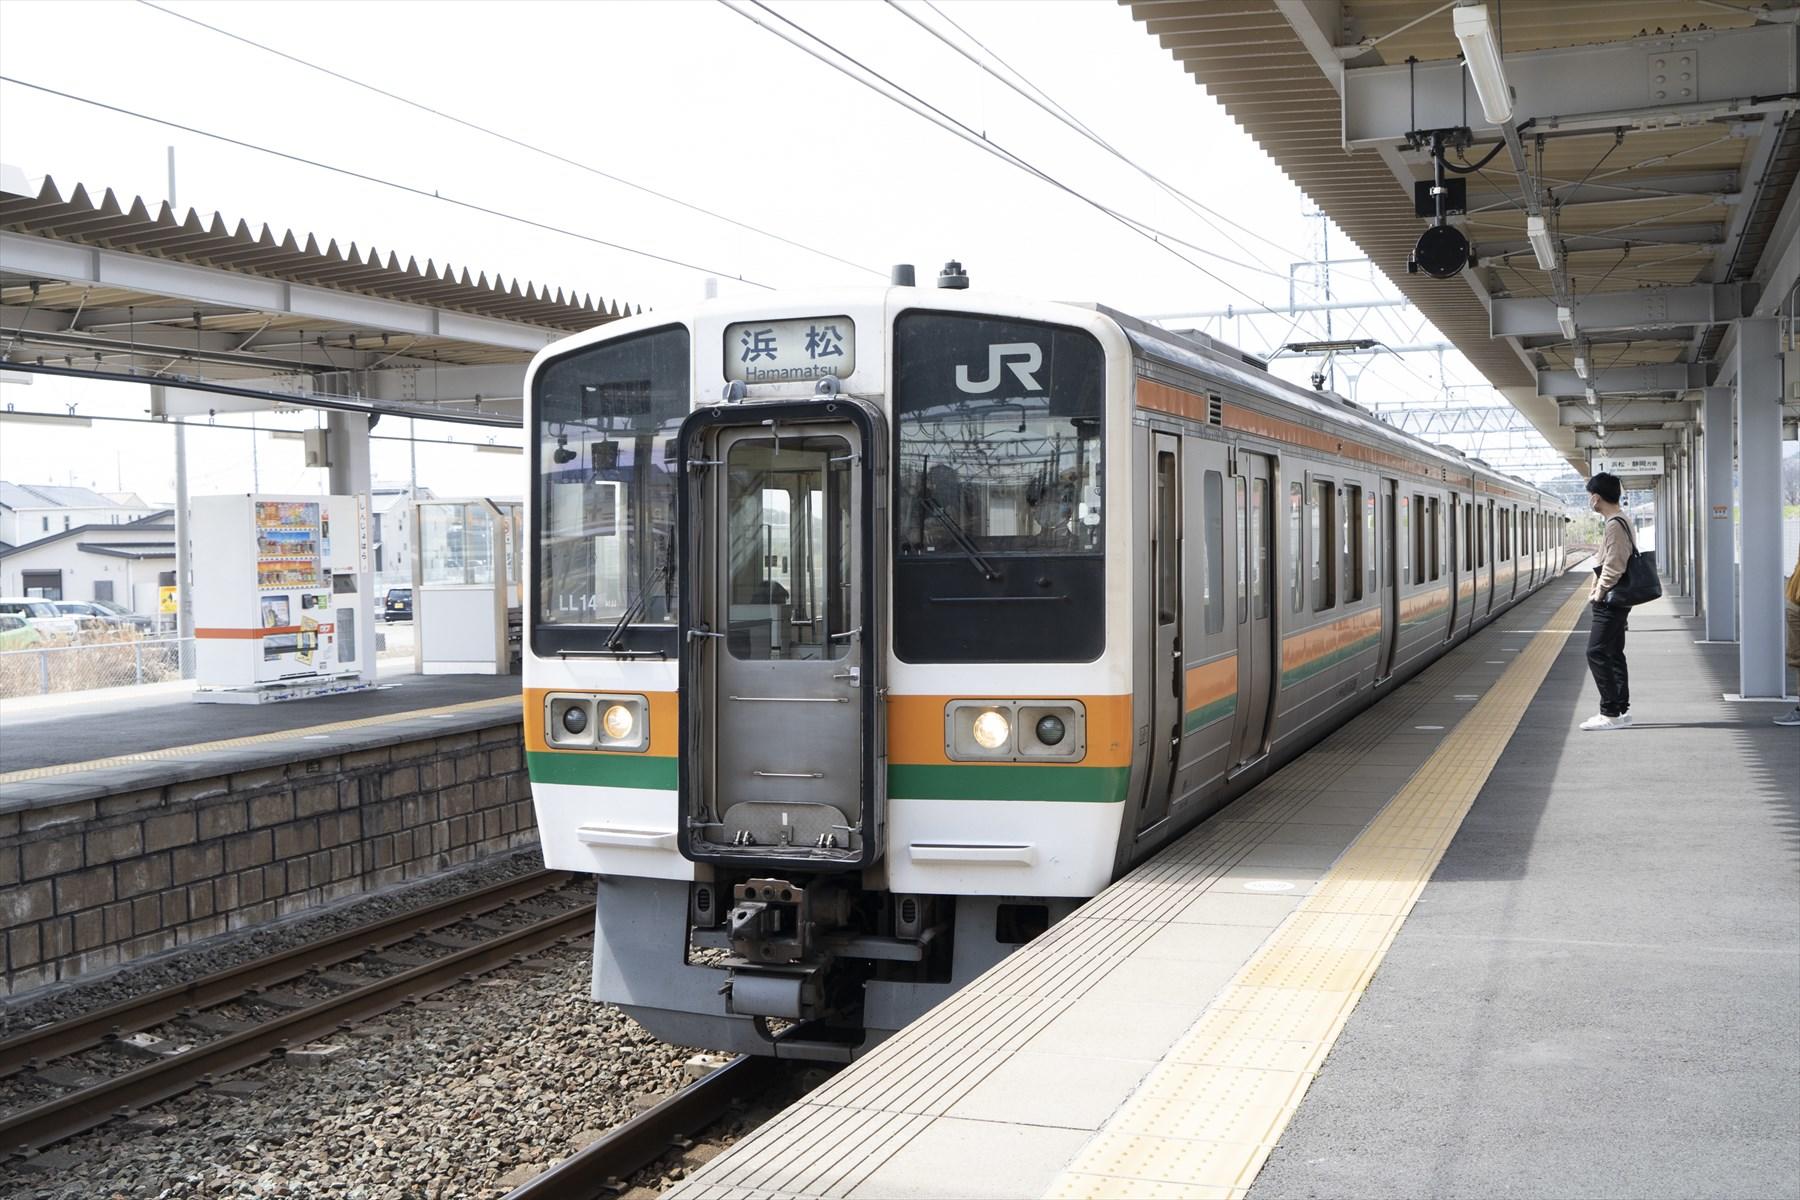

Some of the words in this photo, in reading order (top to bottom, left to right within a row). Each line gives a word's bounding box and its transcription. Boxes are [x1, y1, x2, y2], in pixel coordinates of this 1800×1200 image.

[740, 325, 844, 363] 浜松
[745, 364, 838, 380] Hamamatsu
[955, 342, 1044, 394] JR
[559, 594, 597, 611] LL14
